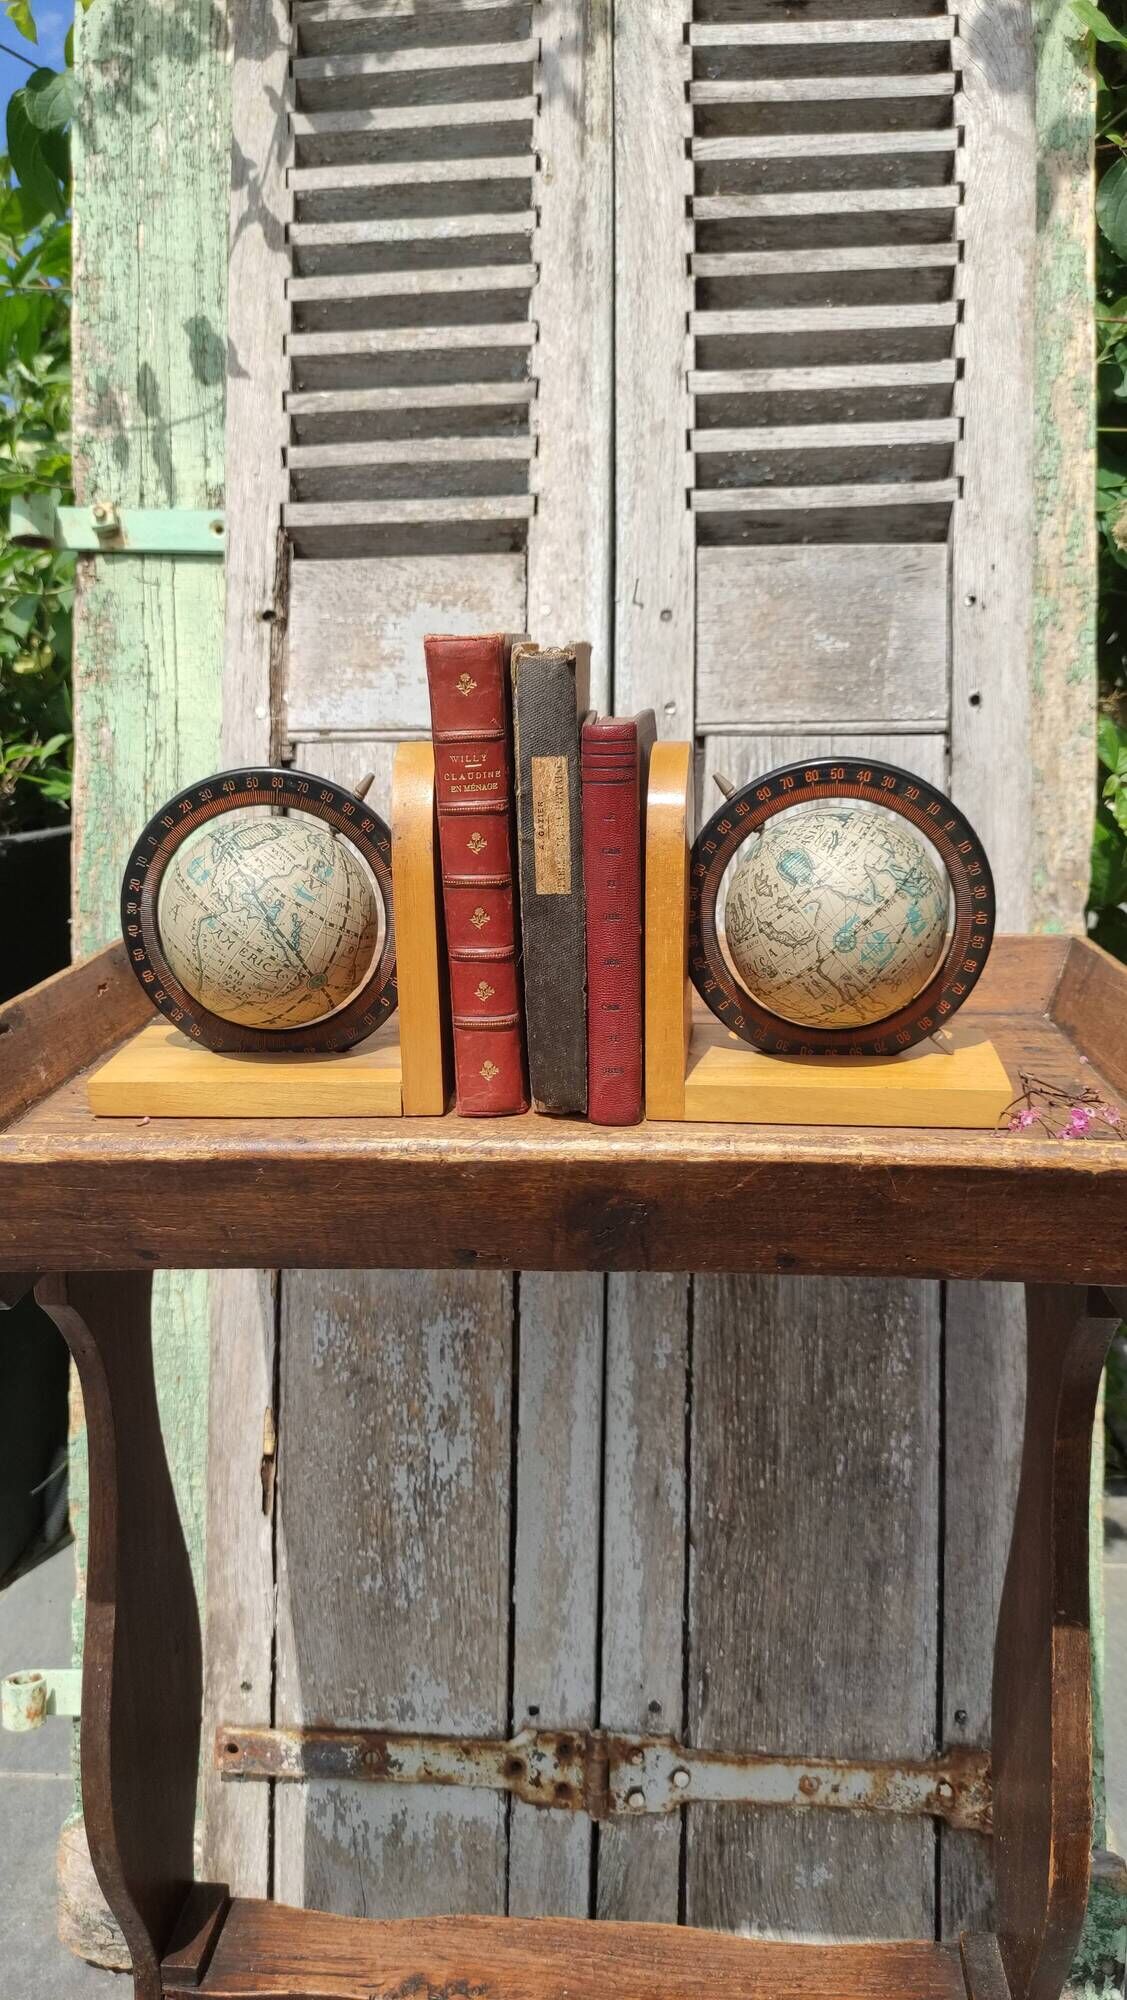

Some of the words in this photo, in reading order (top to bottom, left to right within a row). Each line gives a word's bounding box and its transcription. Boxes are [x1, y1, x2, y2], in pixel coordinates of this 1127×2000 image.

[449, 752, 487, 762] WILLY
[444, 770, 501, 781] CLAUDINE
[805, 769, 819, 783] 60
[831, 768, 845, 780] 50
[857, 770, 872, 782] 40
[222, 780, 235, 792] 40
[246, 776, 259, 788] 50
[271, 777, 284, 788] 60
[297, 781, 309, 793] 70
[450, 785, 462, 793] EN
[780, 776, 794, 790] 70
[881, 775, 897, 789] 30
[199, 788, 213, 802] 30
[320, 790, 334, 803] 80
[756, 786, 772, 800] 80
[905, 786, 921, 800] 20
[179, 800, 193, 814] 20
[343, 802, 356, 816] 90
[735, 802, 750, 816] 90
[927, 802, 942, 816] 10
[161, 815, 174, 829] 10
[361, 819, 375, 833] 80
[536, 801, 545, 837] GAZIER
[944, 820, 956, 830] 0
[717, 819, 732, 834] 80
[377, 839, 390, 852] 70
[702, 840, 717, 854] 70
[958, 840, 972, 854] 10
[136, 856, 148, 868] 10
[968, 862, 982, 876] 20
[129, 878, 141, 892] 20
[974, 885, 987, 900] 30
[127, 902, 138, 915] 30
[975, 911, 988, 925] 40
[127, 924, 138, 938] 40
[208, 929, 283, 980] AMERICA
[155, 990, 168, 1004] 70
